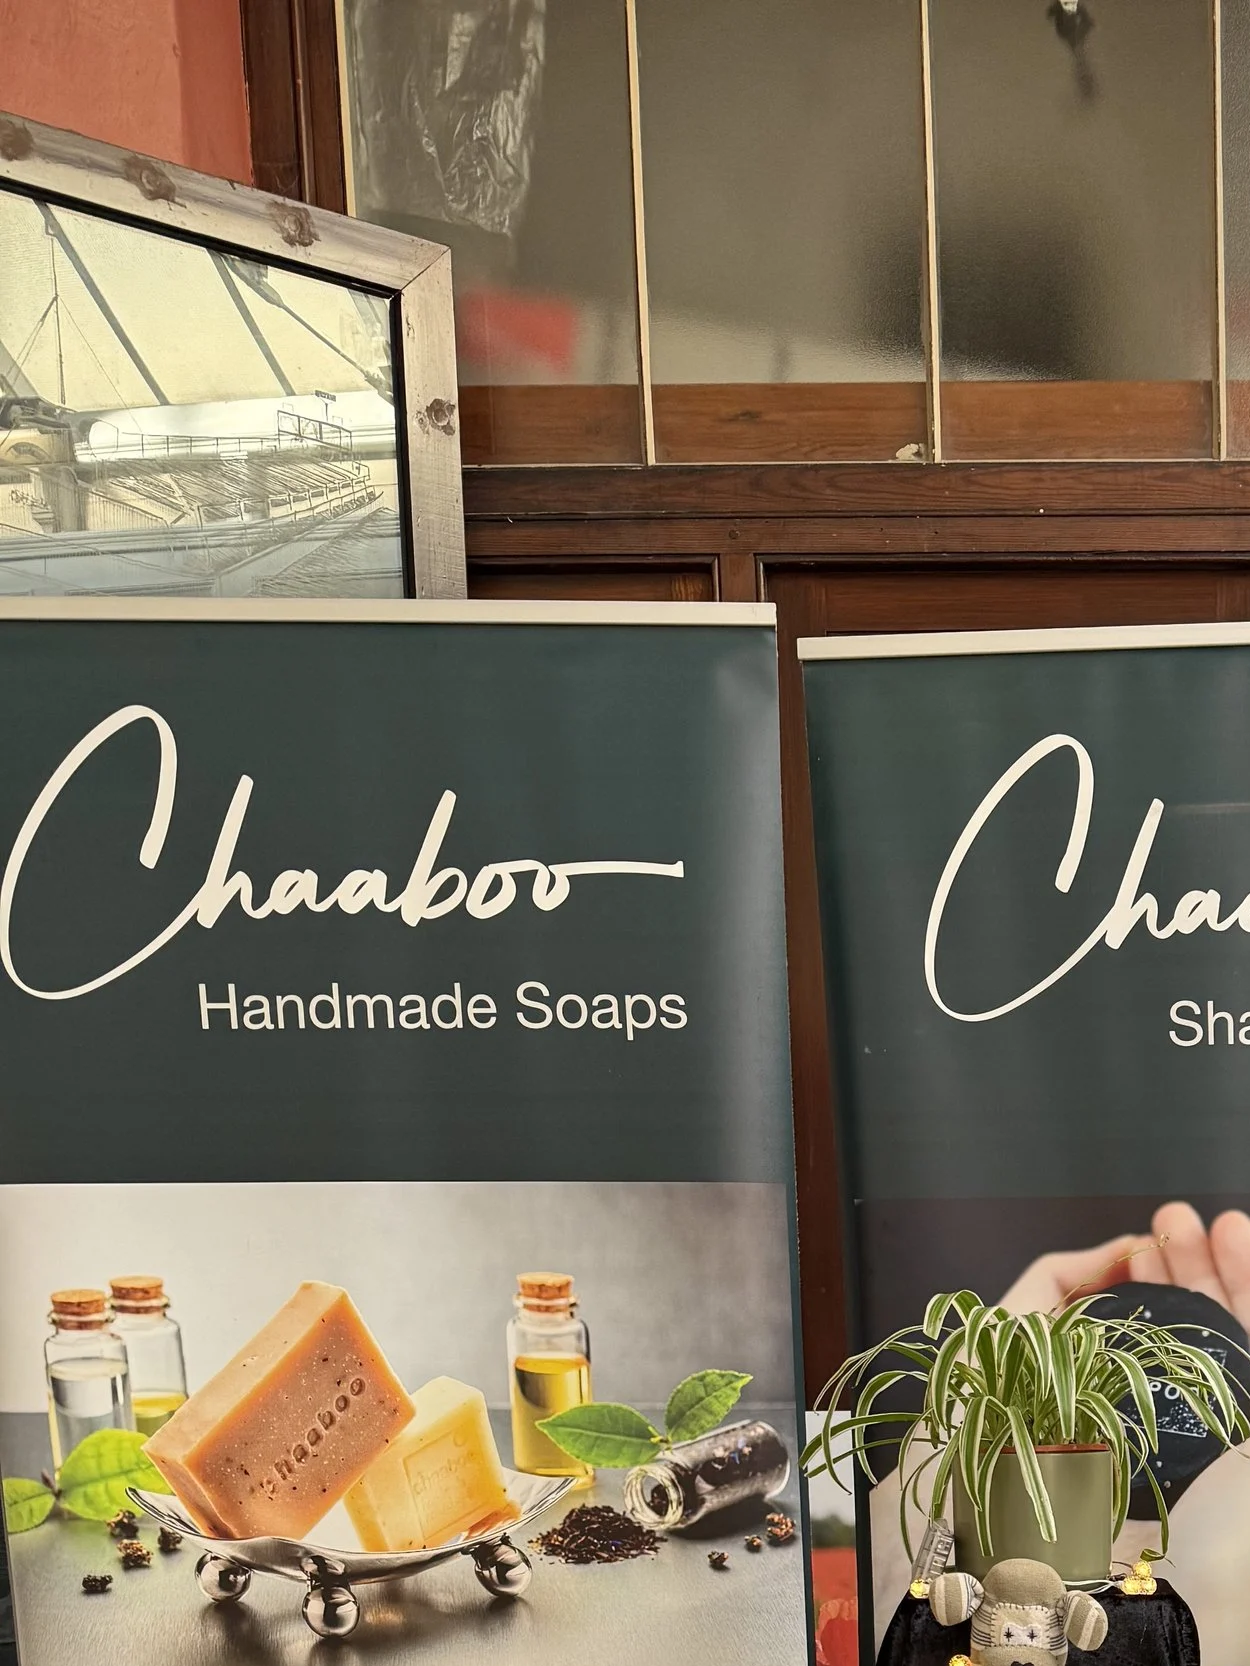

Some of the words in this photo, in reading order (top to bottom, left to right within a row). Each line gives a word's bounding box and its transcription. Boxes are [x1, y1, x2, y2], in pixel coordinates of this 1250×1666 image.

[0, 704, 685, 1000] Chaaboo
[199, 983, 497, 1030] Handmade
[515, 982, 688, 1040] Soaps
